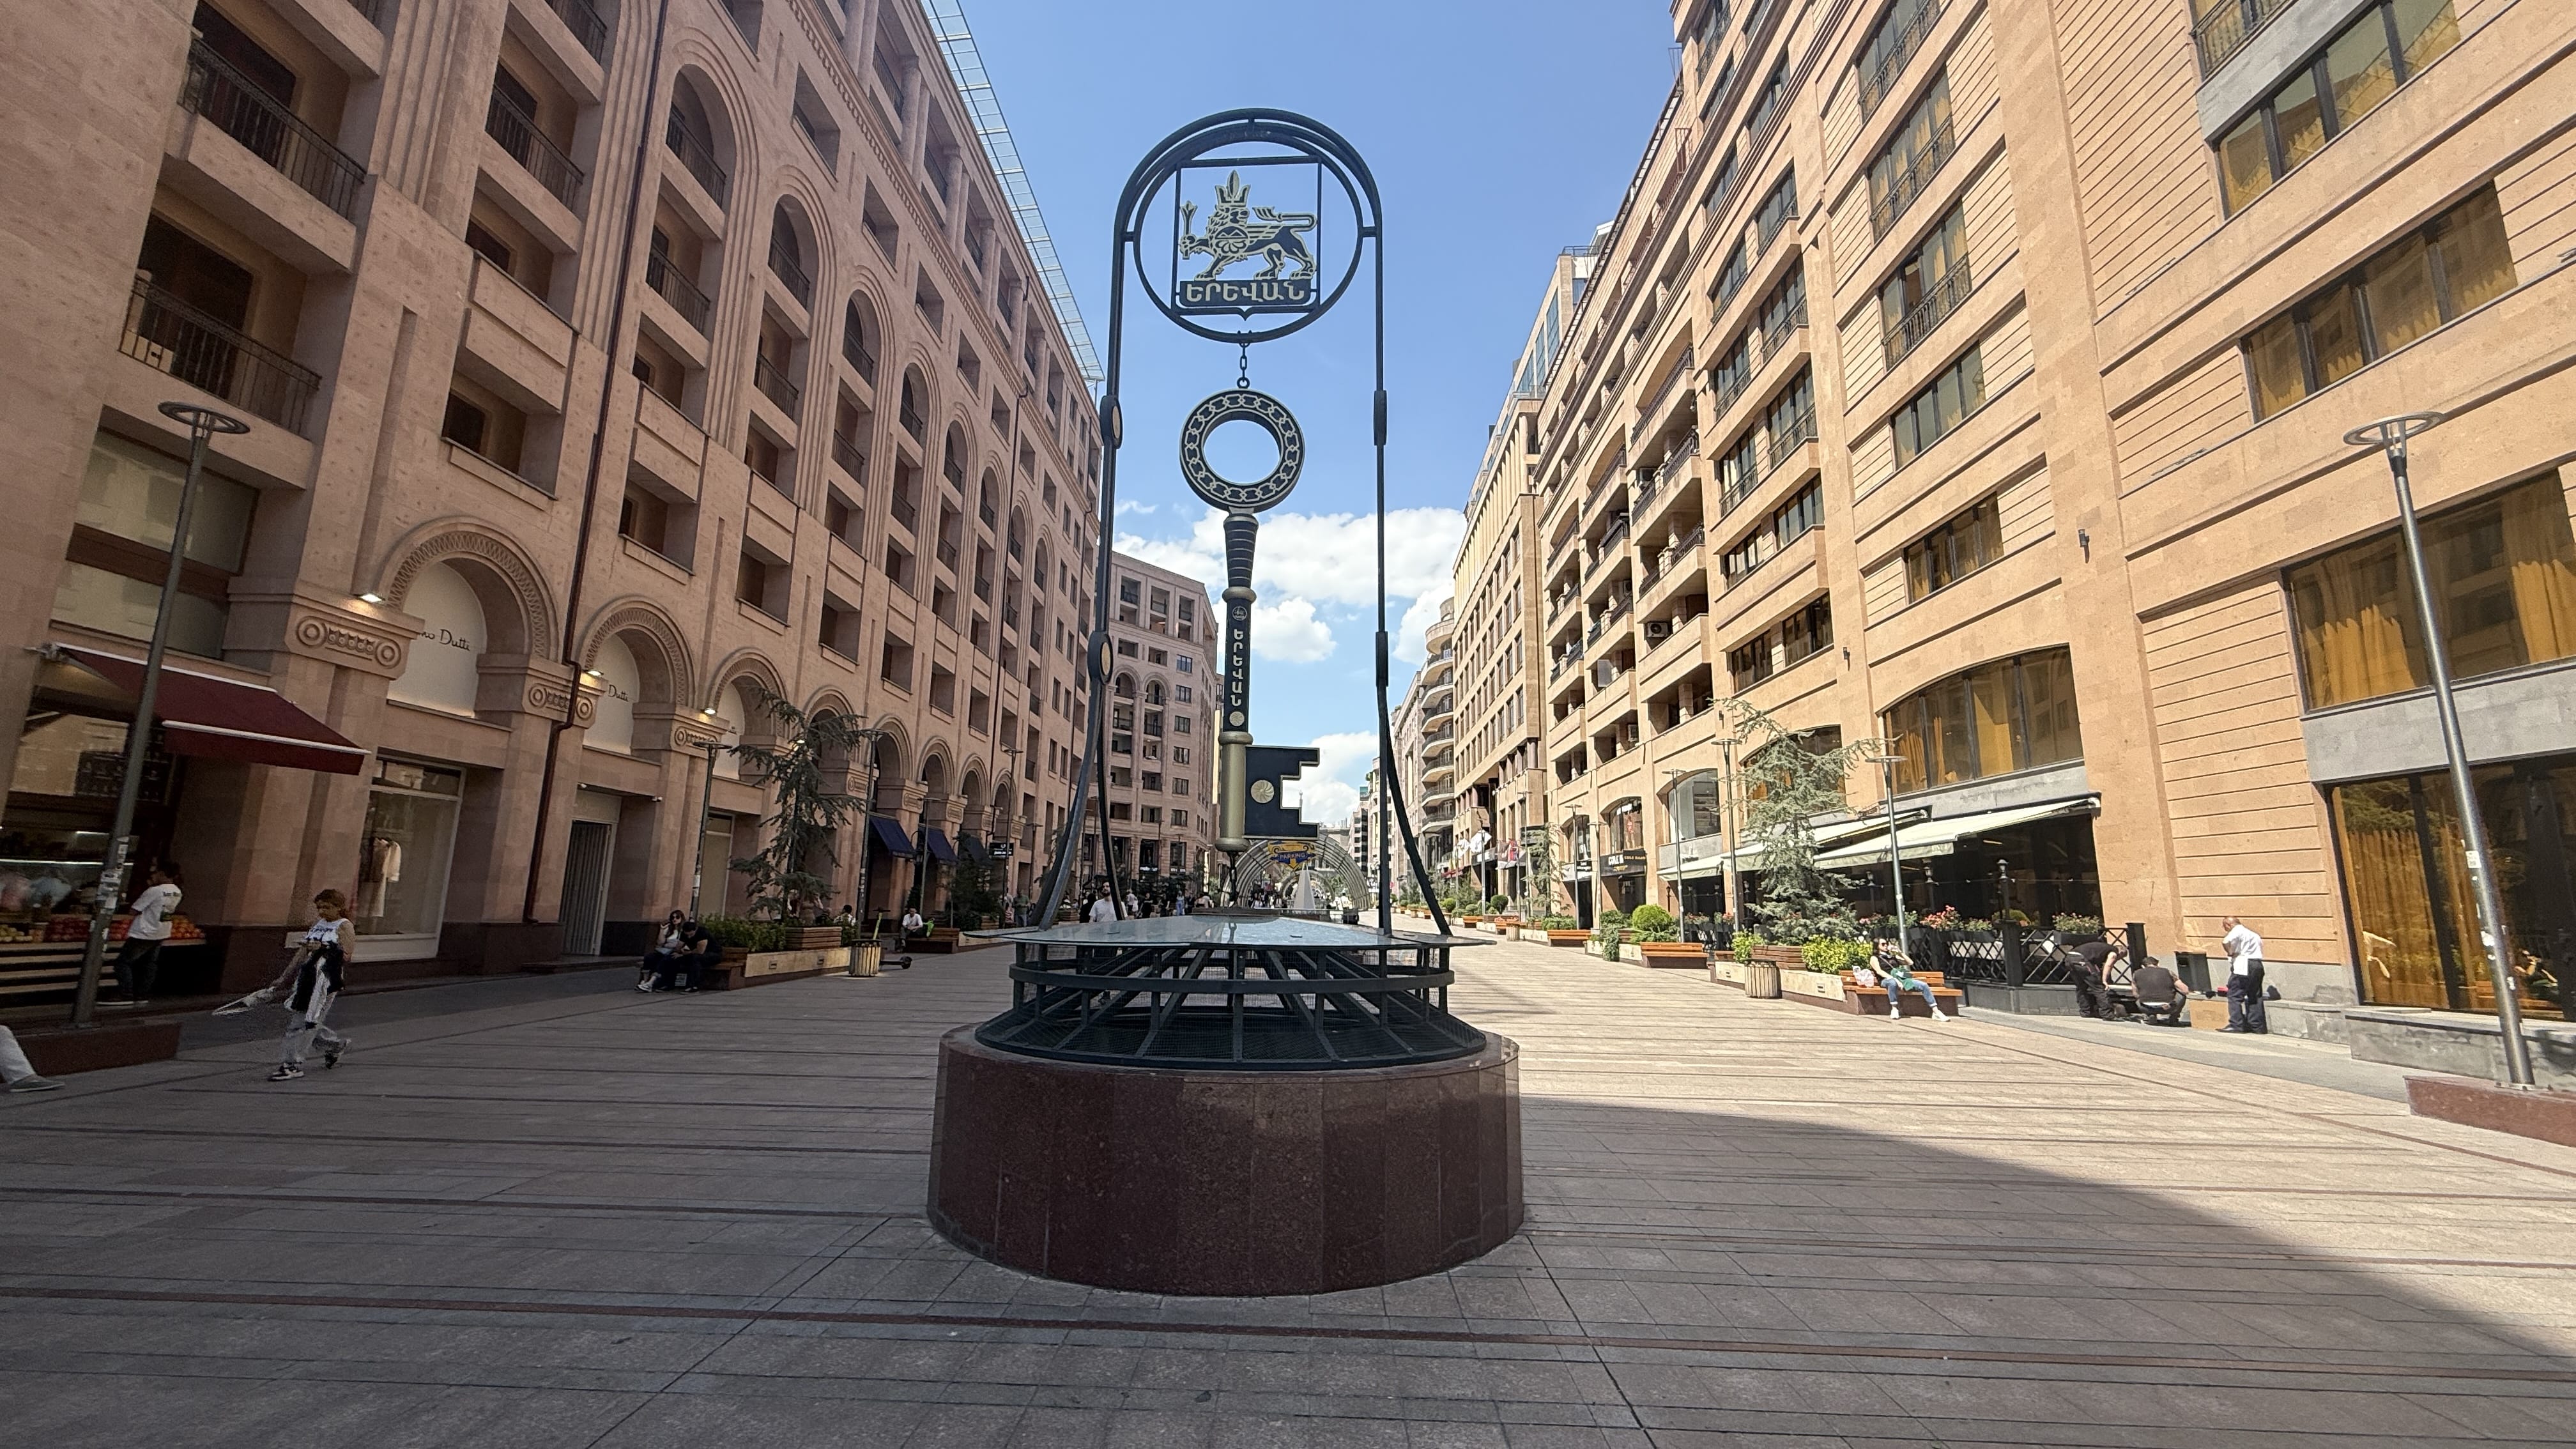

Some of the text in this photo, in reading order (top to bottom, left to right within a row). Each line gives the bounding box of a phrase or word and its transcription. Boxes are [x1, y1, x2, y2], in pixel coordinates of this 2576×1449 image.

[1186, 282, 1305, 302] ԵՐԵՎԱՆ
[439, 629, 470, 651] Dutti
[1230, 629, 1244, 707] ԵՐԵՎԱՆ
